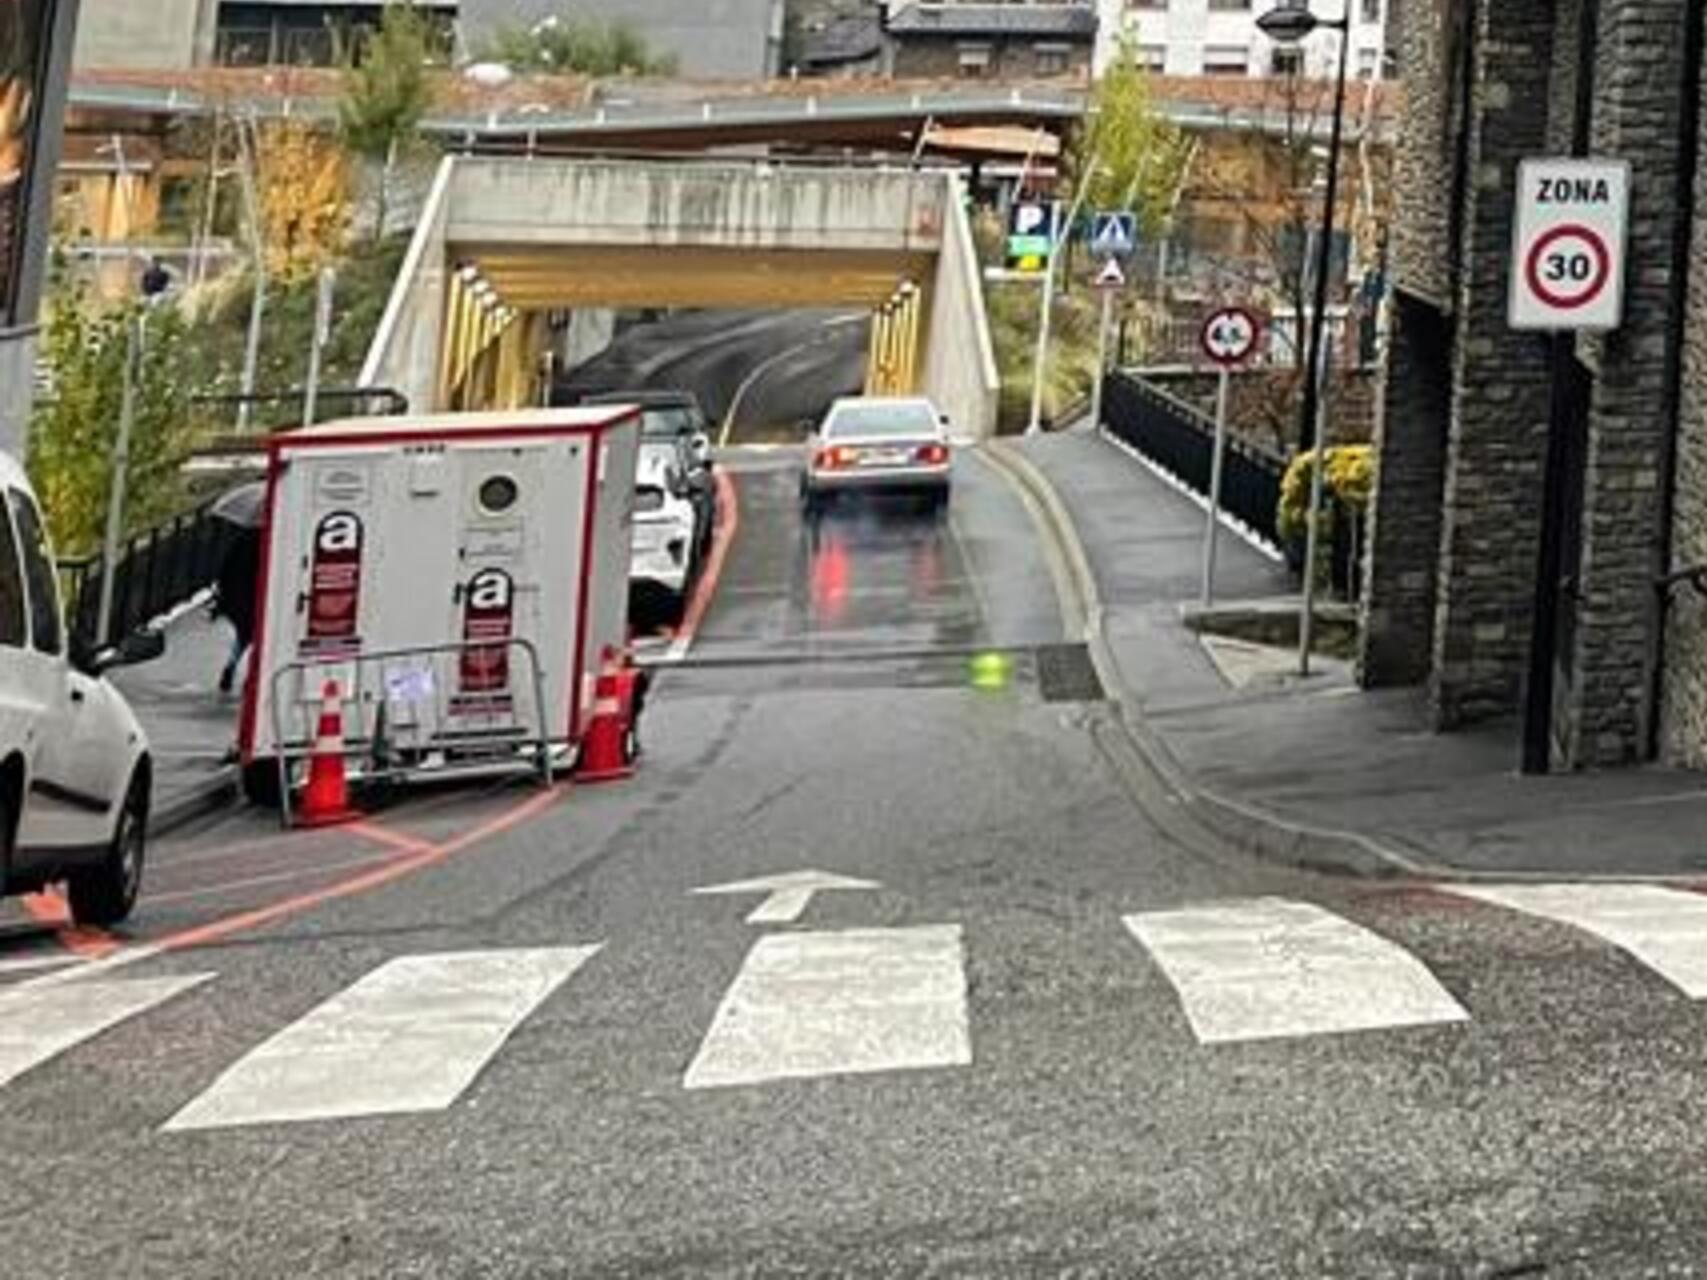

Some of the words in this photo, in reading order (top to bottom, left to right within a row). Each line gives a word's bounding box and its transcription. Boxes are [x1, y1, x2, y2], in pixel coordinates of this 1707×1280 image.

[1536, 178, 1609, 204] ZONA
[1016, 206, 1044, 233] P
[1546, 254, 1590, 281] 30
[319, 515, 357, 552] a
[470, 572, 509, 609] a
